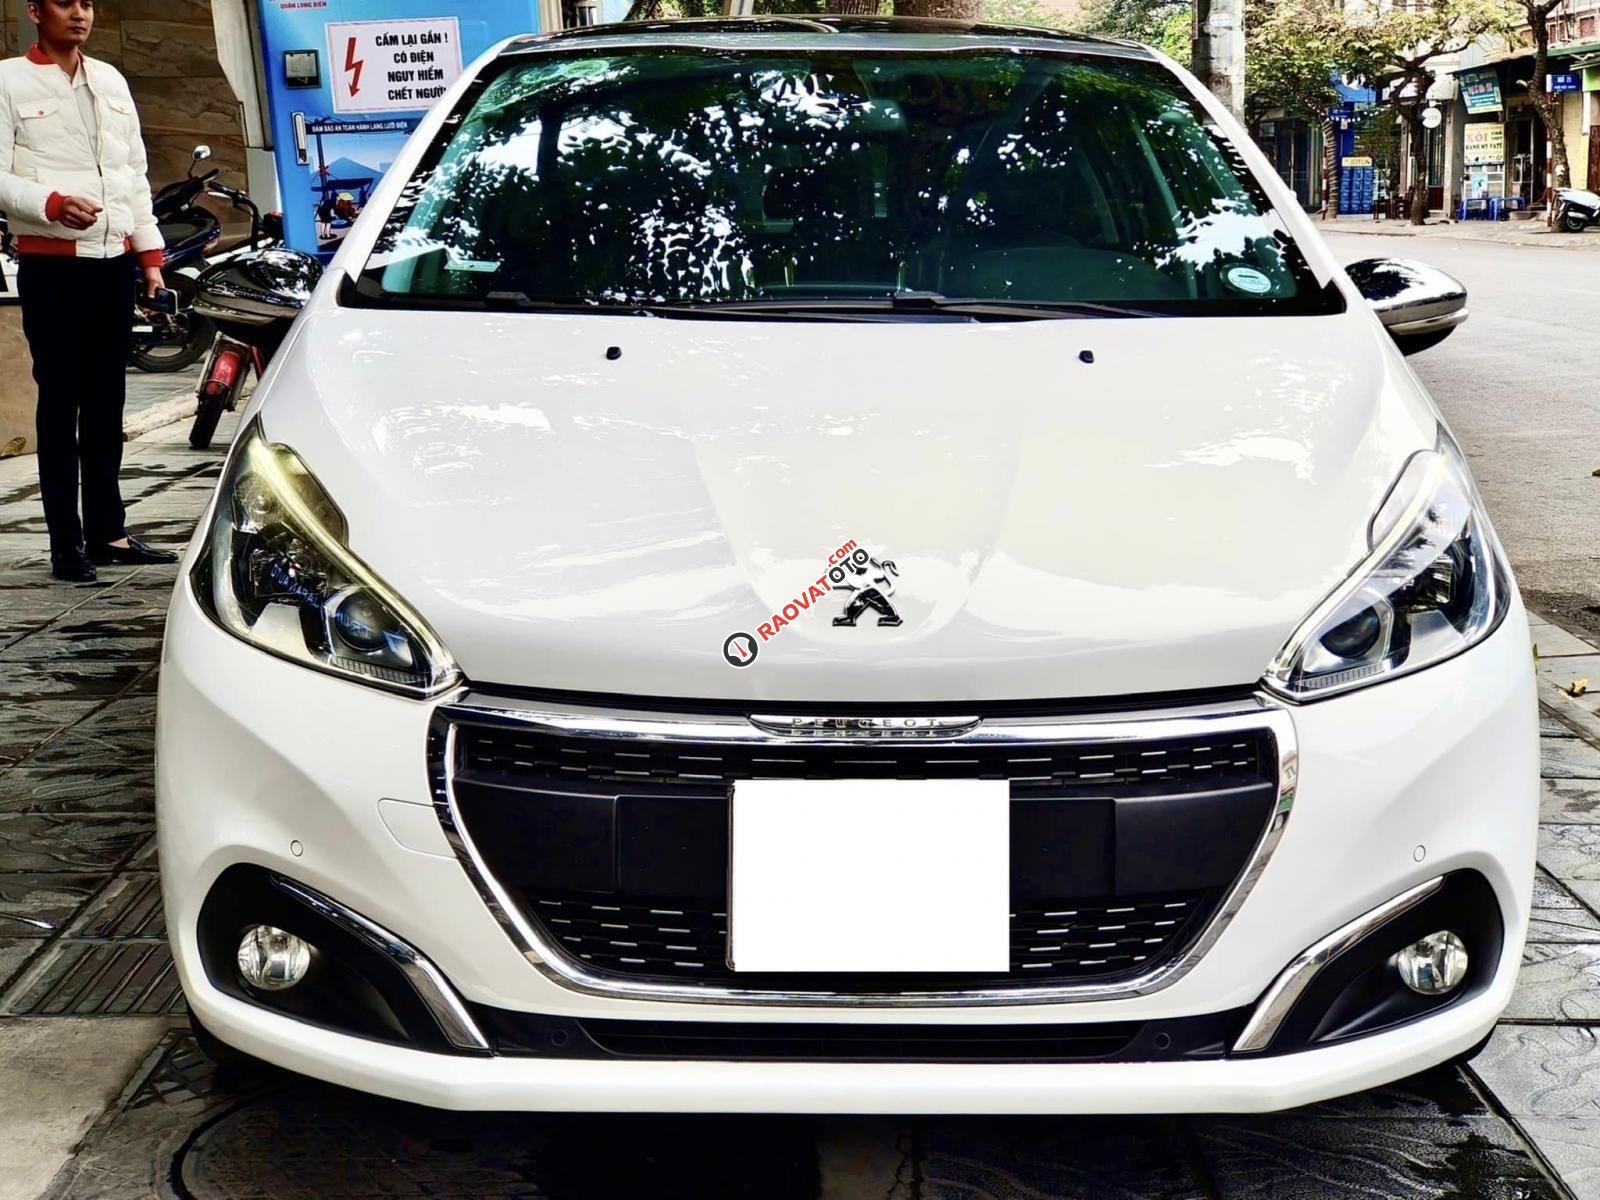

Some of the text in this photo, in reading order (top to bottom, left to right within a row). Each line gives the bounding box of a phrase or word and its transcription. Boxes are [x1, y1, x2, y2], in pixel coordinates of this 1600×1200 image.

[375, 31, 399, 47] CẤM
[401, 33, 418, 48] LẠI
[444, 32, 449, 44] !
[393, 49, 435, 65] CÓ ĐIỆN
[387, 65, 444, 83] NGUY HIỂM
[387, 85, 413, 101] CHẾT
[334, 124, 342, 132] AN
[791, 717, 938, 729] PEUGEOT
